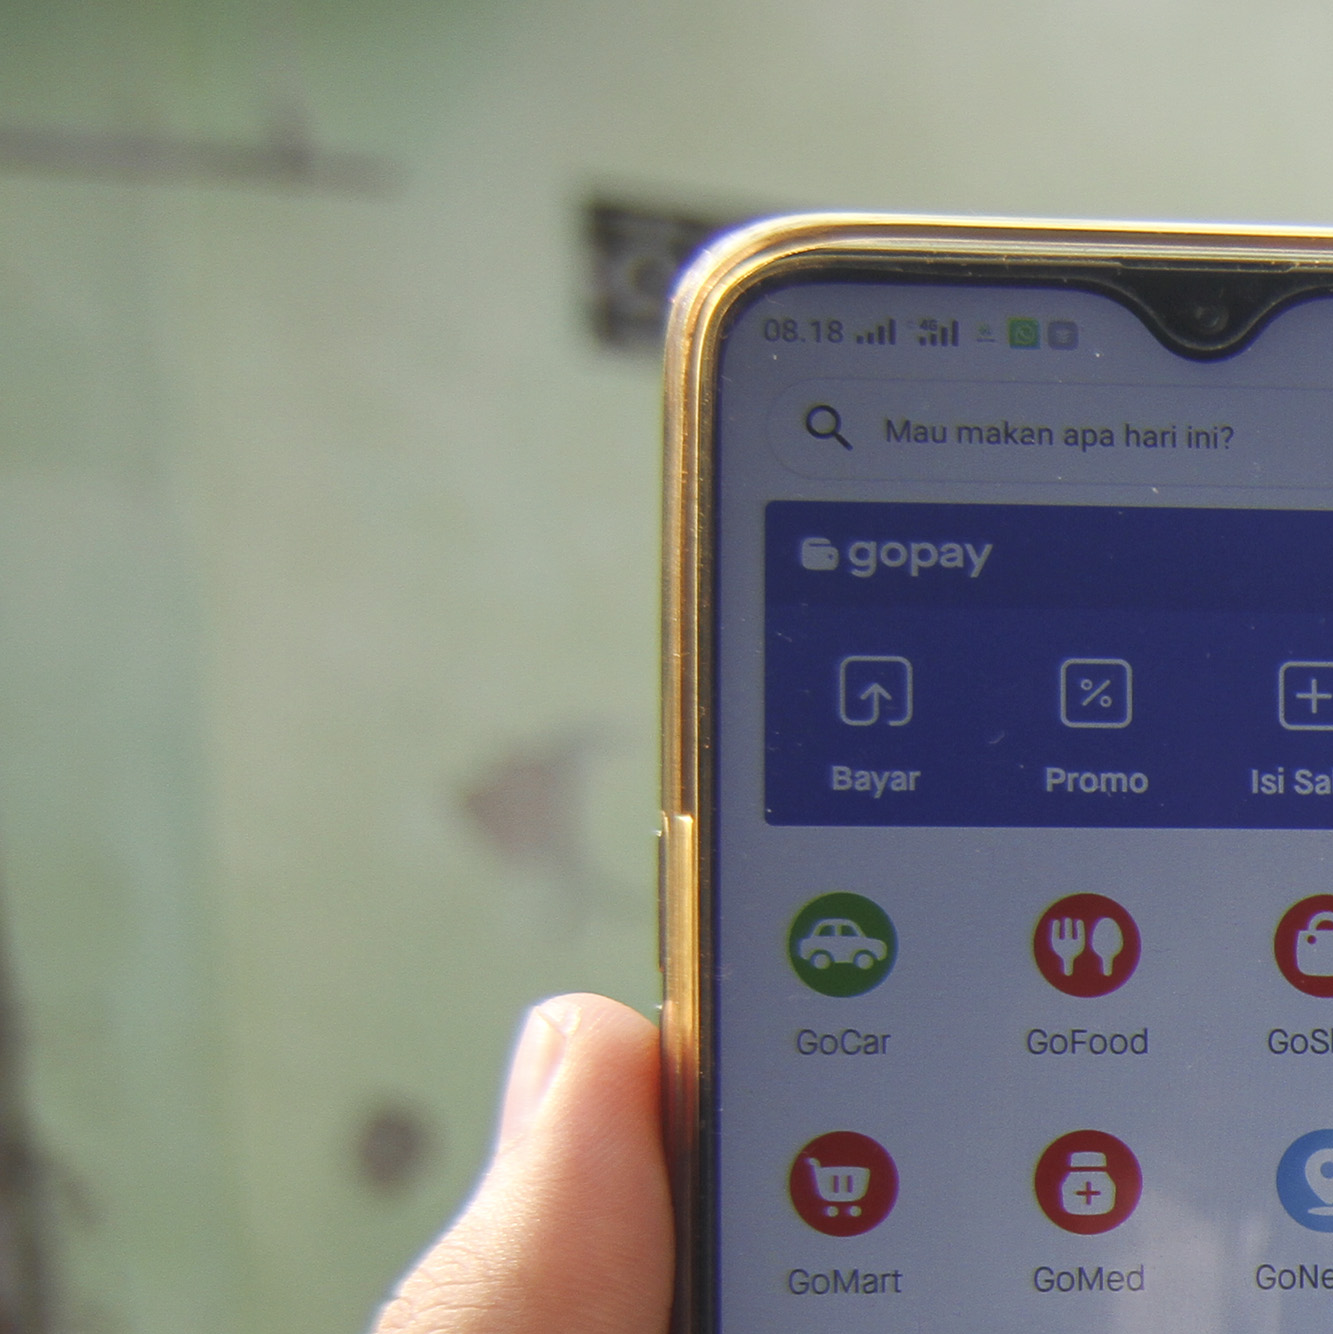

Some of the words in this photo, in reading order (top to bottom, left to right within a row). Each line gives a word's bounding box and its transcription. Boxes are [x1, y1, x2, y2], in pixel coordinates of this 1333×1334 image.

[764, 318, 844, 345] 08.18
[886, 418, 948, 447] Mau
[957, 418, 1054, 448] makan
[1064, 425, 1116, 454] apa
[1124, 422, 1178, 449] hari
[1185, 423, 1235, 451] ini?
[848, 540, 993, 577] gopay
[832, 765, 920, 798] Bayar
[1046, 767, 1149, 793] Promo
[1251, 767, 1284, 795] Isi
[796, 1028, 891, 1056] GoCar
[1027, 1028, 1149, 1055] GoFood
[788, 1267, 902, 1296] GoMart
[1033, 1264, 1146, 1293] GoMed
